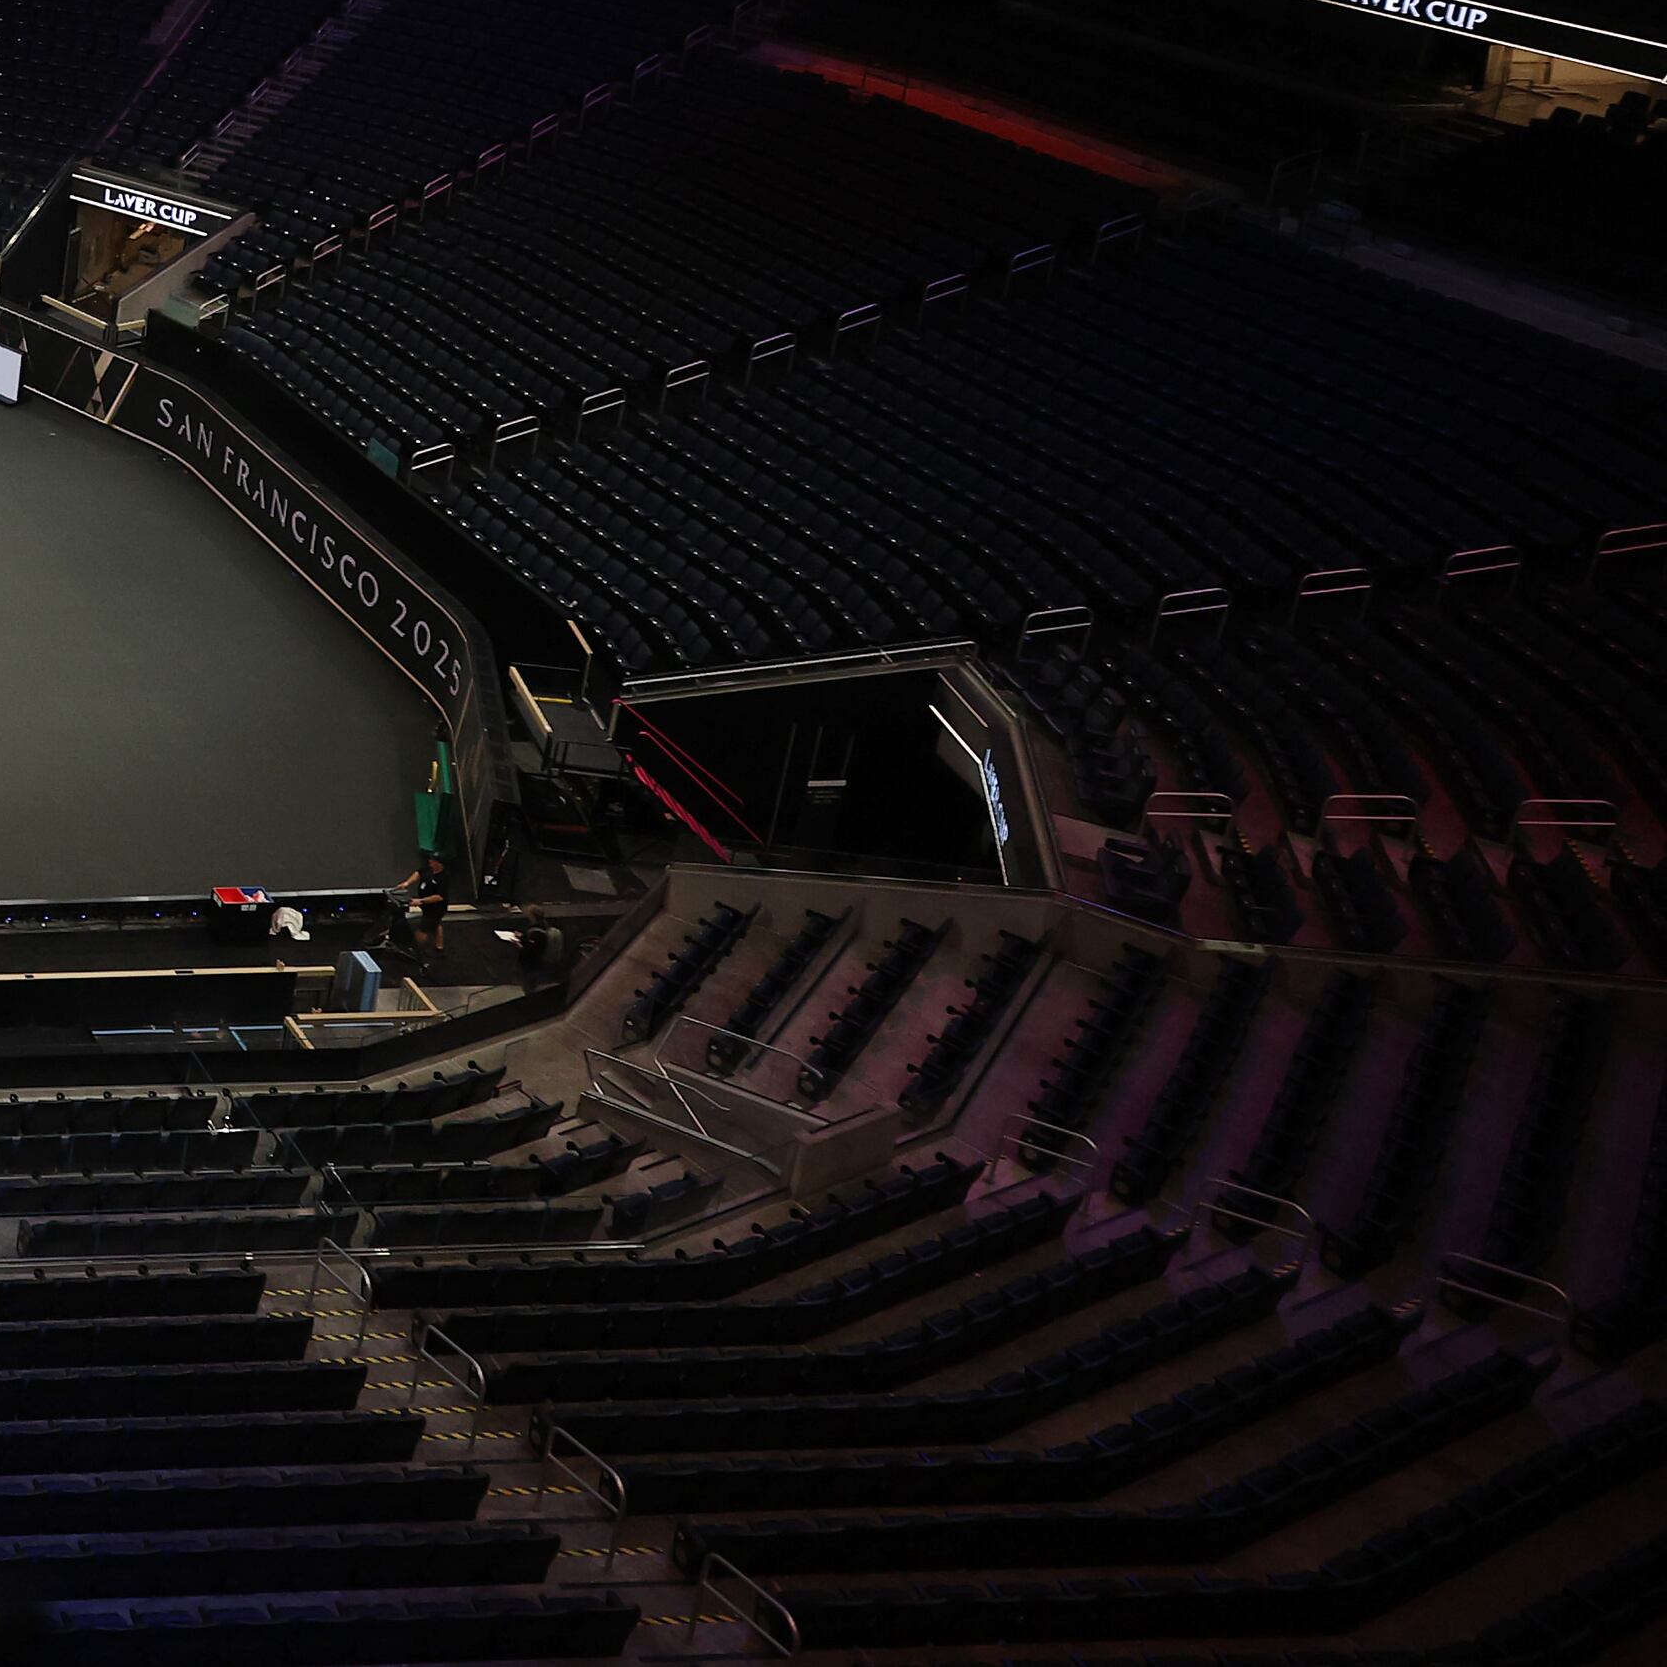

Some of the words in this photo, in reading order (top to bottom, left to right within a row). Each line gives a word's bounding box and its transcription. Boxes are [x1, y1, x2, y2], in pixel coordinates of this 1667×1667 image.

[1424, 0, 1489, 31] CUP
[103, 188, 157, 218] LAVER
[159, 203, 198, 226] CUP
[155, 396, 213, 459] SAN
[222, 443, 381, 609] FRANCISCO
[389, 598, 463, 697] 2025
